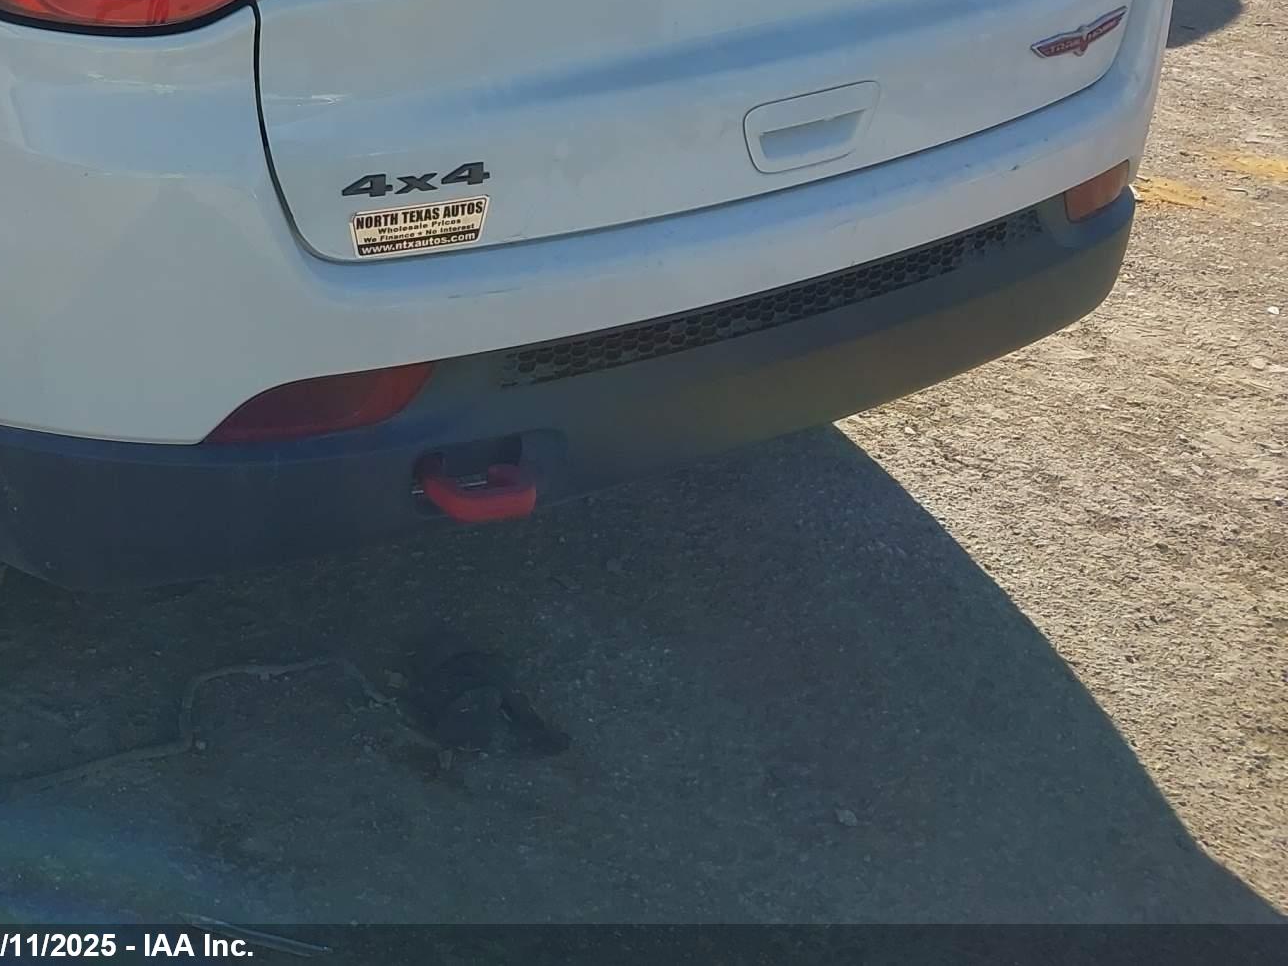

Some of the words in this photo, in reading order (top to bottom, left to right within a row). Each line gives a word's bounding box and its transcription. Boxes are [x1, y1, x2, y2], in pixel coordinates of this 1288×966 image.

[342, 161, 490, 197] 4x4
[356, 213, 398, 230] NORTH
[401, 208, 440, 224] TEXAS
[443, 200, 483, 218] AUTOS
[378, 222, 428, 234] Wholesale
[432, 218, 461, 227] Prices
[361, 232, 476, 254] www.ntxautos.com
[380, 232, 415, 241] Finance
[440, 223, 475, 233] Interest
